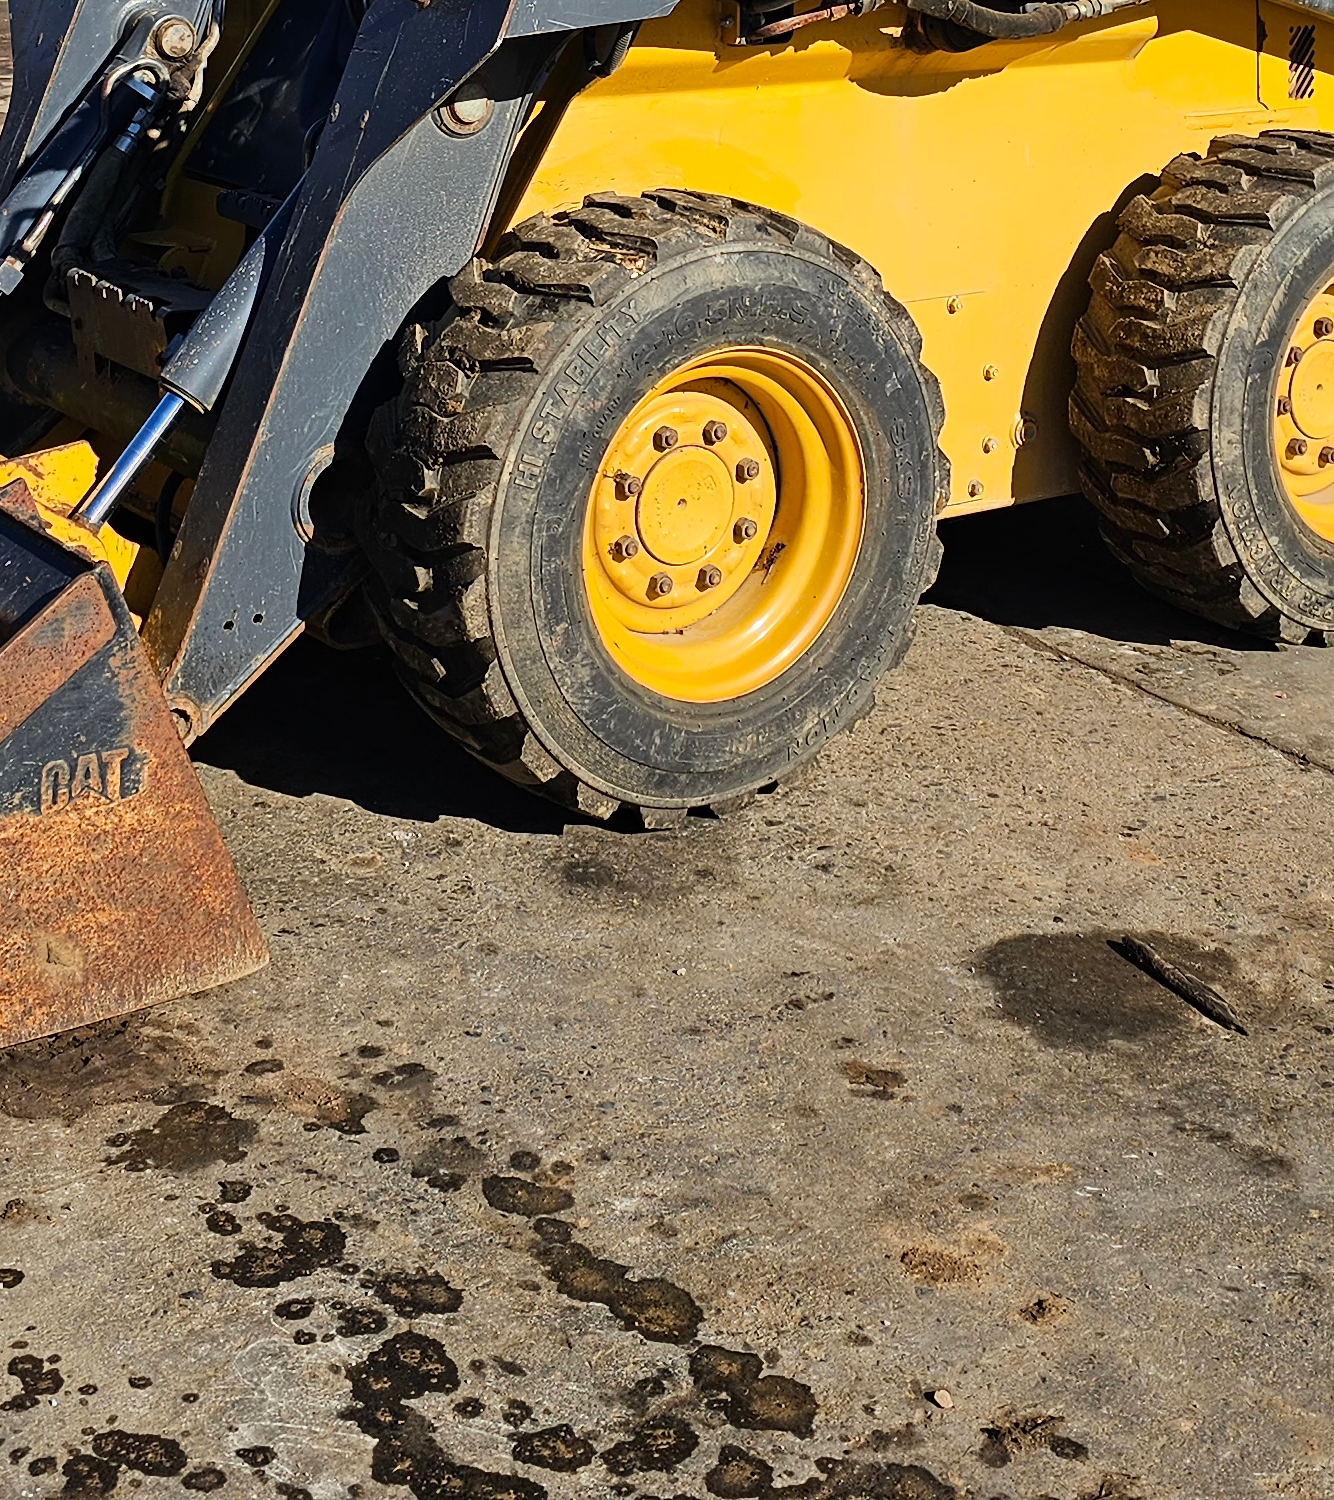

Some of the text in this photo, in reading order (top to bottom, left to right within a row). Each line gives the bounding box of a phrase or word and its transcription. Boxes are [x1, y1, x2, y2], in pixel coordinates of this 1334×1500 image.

[514, 453, 544, 490] HI
[532, 299, 645, 445] STABILITY
[39, 746, 130, 816] CAT
